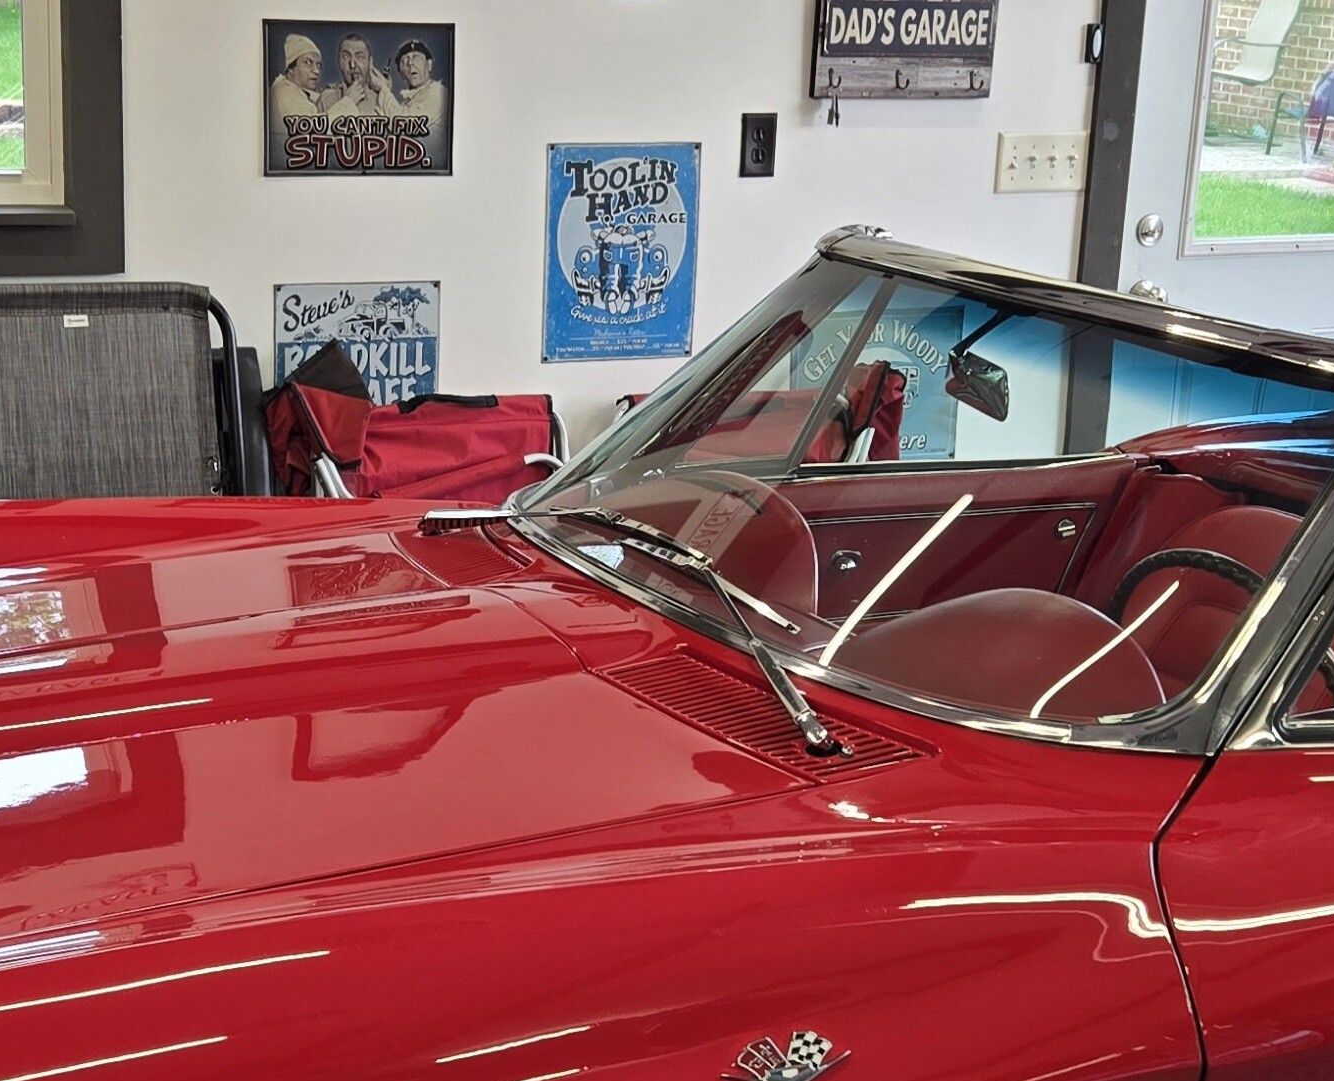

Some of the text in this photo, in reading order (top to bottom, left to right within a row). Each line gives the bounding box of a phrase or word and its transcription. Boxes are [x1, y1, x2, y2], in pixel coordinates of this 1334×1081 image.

[830, 7, 990, 46] DAD'S GARAGE
[284, 115, 429, 135] YOU CAN'T FIX
[287, 135, 431, 168] STUPID.
[585, 181, 670, 222] HAND
[625, 212, 687, 225] GARAGE
[281, 289, 355, 332] Steve's
[570, 305, 593, 321] Give
[594, 315, 608, 324] us
[645, 306, 657, 320] at
[284, 340, 432, 380] RDKILL
[802, 318, 949, 382] GET YR WOODY
[368, 375, 417, 407] AFE
[899, 434, 926, 450] ere
